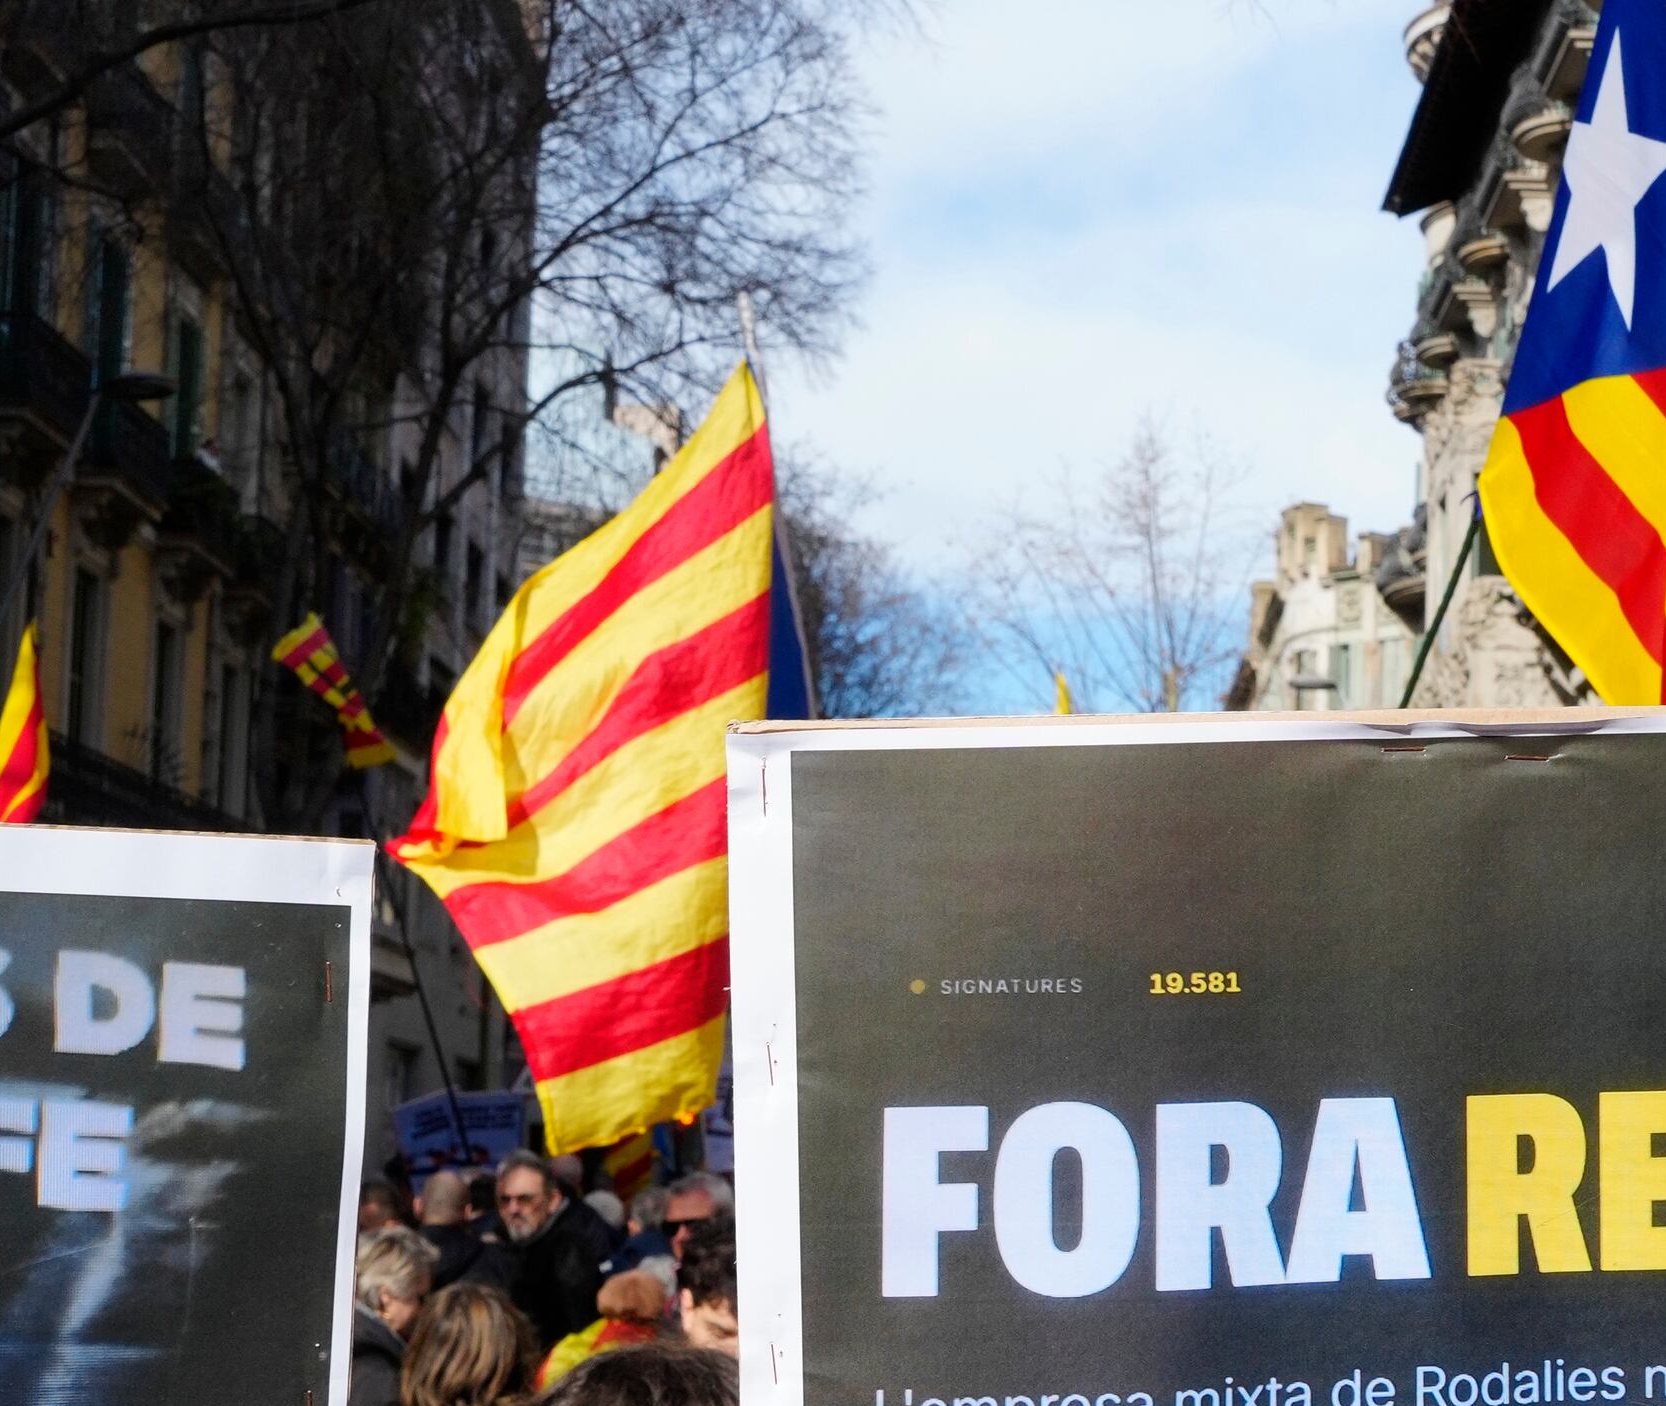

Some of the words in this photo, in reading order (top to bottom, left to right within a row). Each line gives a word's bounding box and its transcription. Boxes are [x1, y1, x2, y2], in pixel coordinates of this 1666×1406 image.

[53, 949, 248, 1071] DE
[940, 978, 1083, 995] SIGNATURES
[1149, 972, 1241, 995] 19.581
[882, 1097, 1433, 1298] FORA
